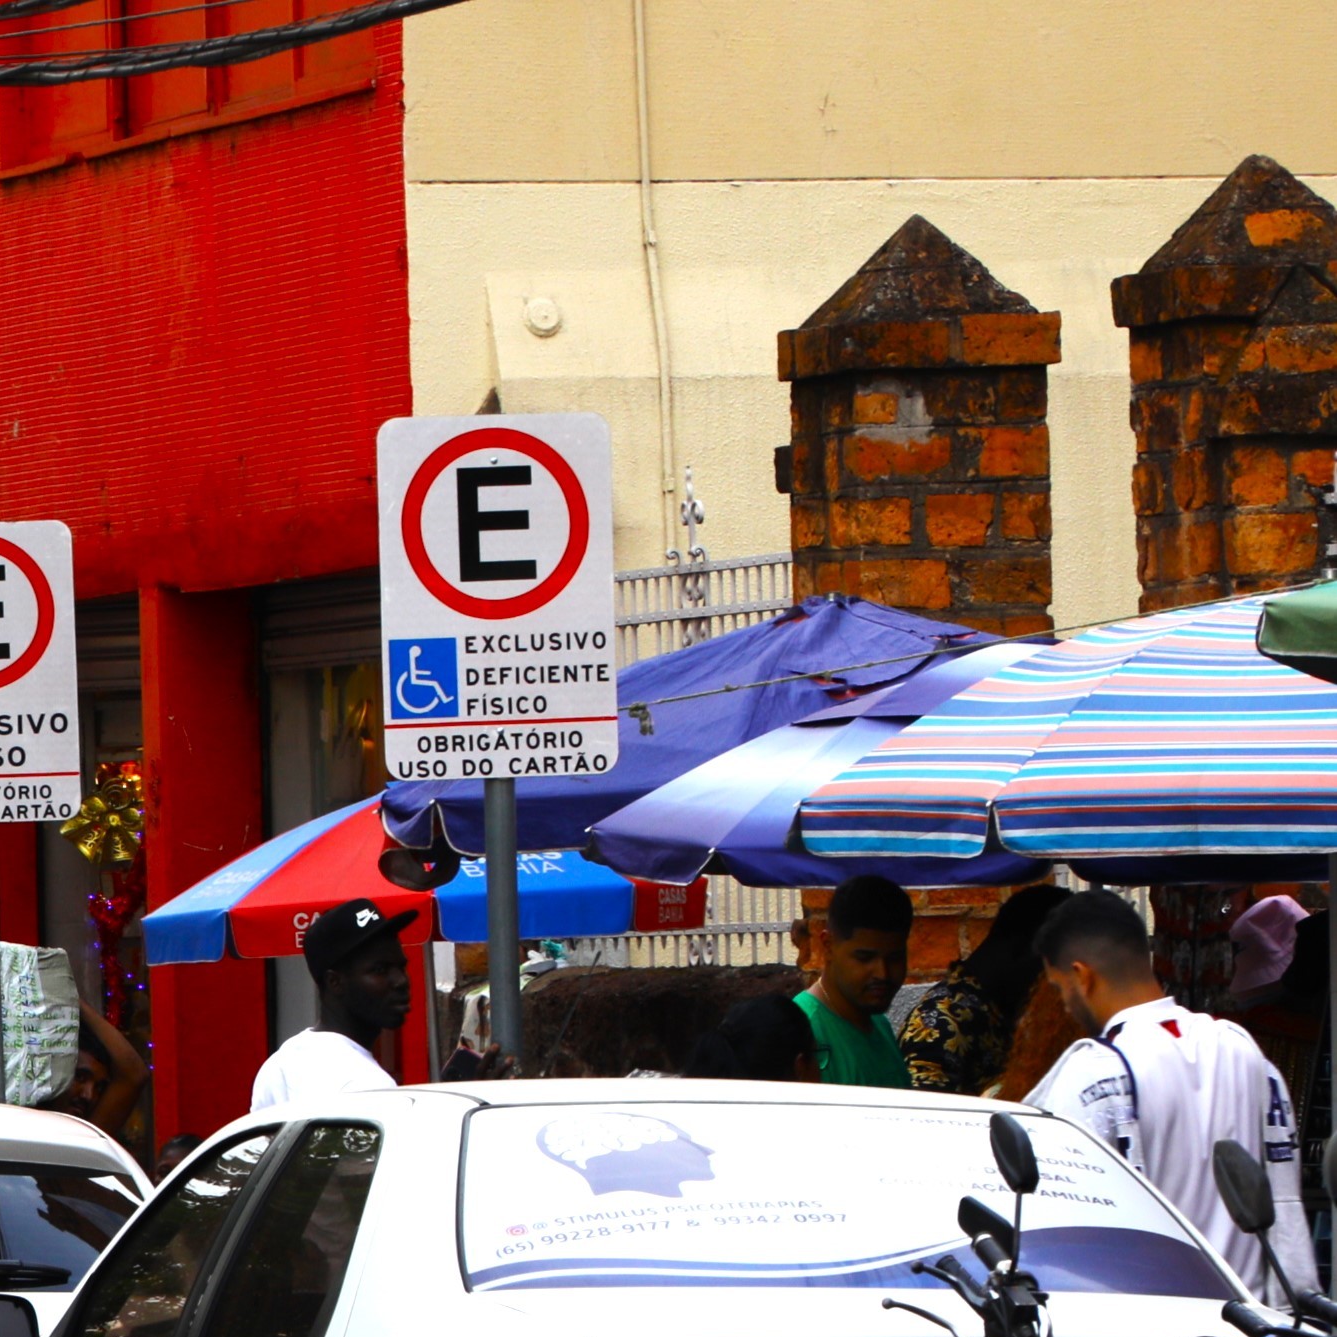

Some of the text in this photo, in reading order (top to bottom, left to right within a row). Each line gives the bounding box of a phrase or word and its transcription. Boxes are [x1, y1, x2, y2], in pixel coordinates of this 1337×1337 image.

[456, 464, 537, 582] E
[465, 631, 607, 654] EXCLUSIVO
[465, 664, 610, 686] DEFICIENTE
[466, 693, 548, 716] FÍSICO
[417, 728, 583, 753] OBRIGATÓRIO
[398, 752, 609, 779] USO DO CARTÃO
[658, 888, 688, 905] CASAS
[553, 1206, 660, 1228] STIMULUS
[664, 1200, 824, 1215] PSICOTERAPIAS
[495, 1239, 535, 1259] (65)
[540, 1219, 672, 1246] 99228-9177
